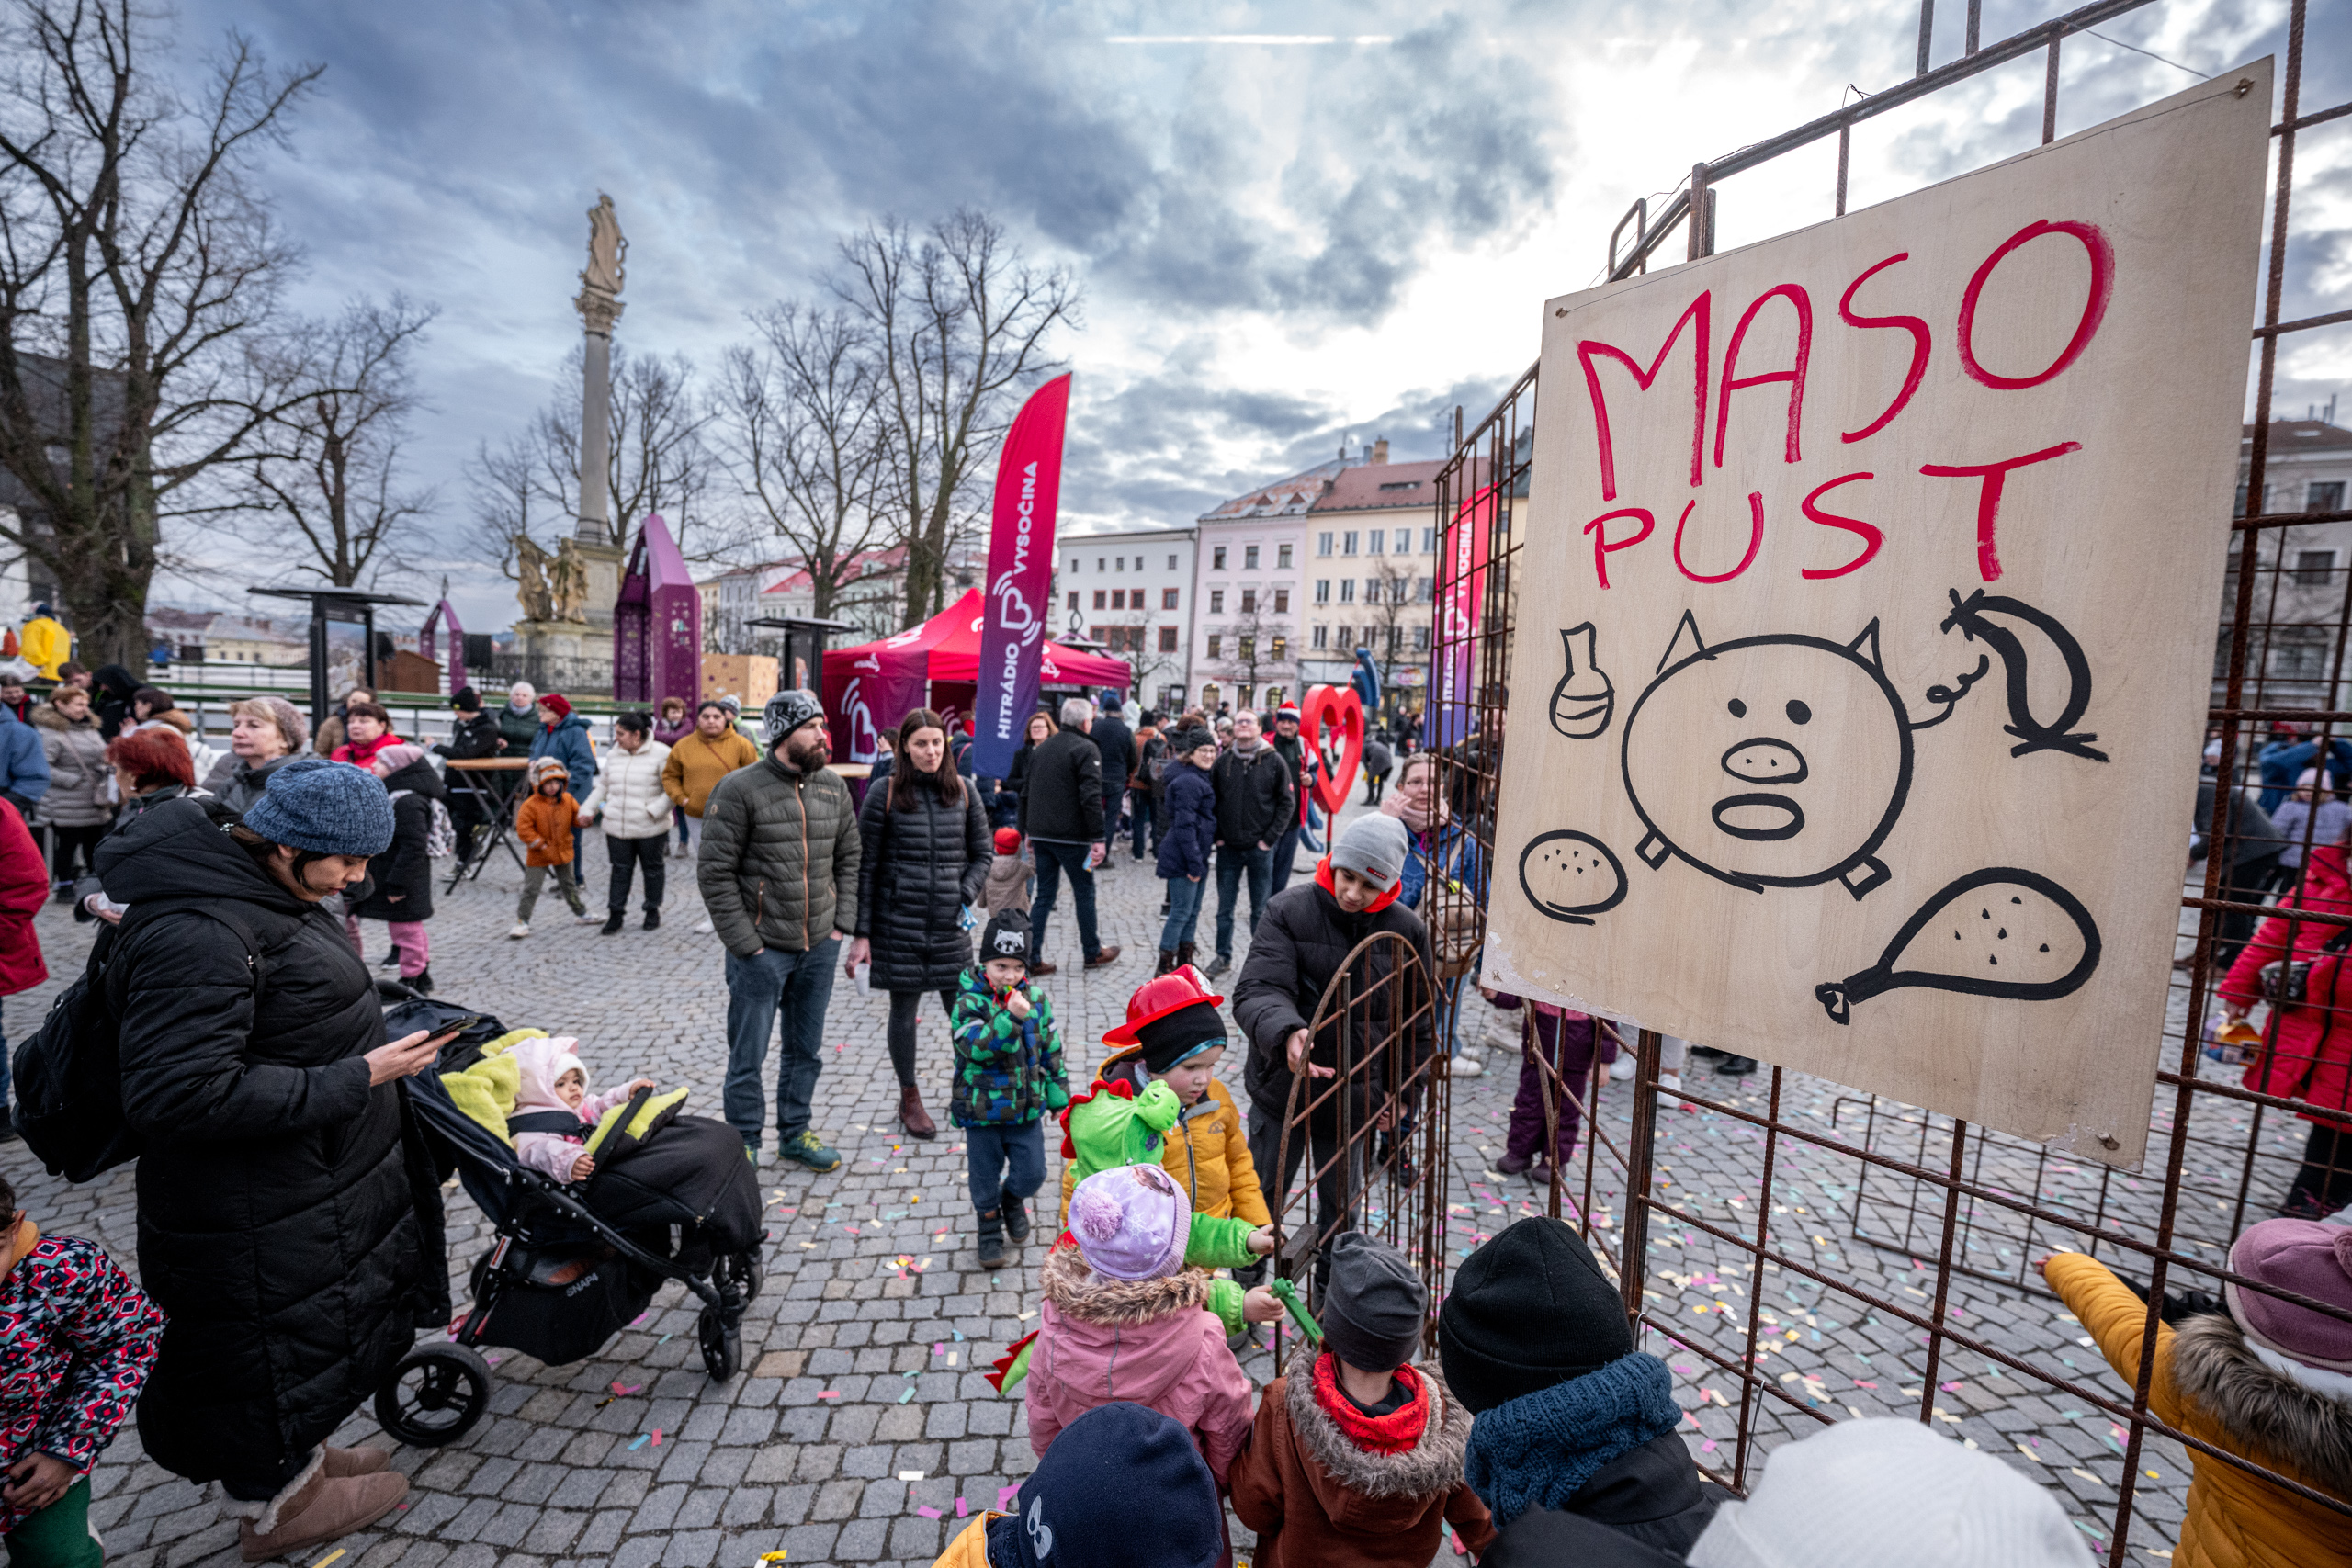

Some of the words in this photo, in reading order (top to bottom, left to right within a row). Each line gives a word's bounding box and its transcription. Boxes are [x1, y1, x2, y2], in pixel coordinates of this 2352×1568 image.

[1575, 220, 2115, 502] MASO
[997, 642, 1020, 739] HITRÁDIO
[1013, 460, 1038, 575] VYSOČINA
[1583, 441, 2084, 590] PUST
